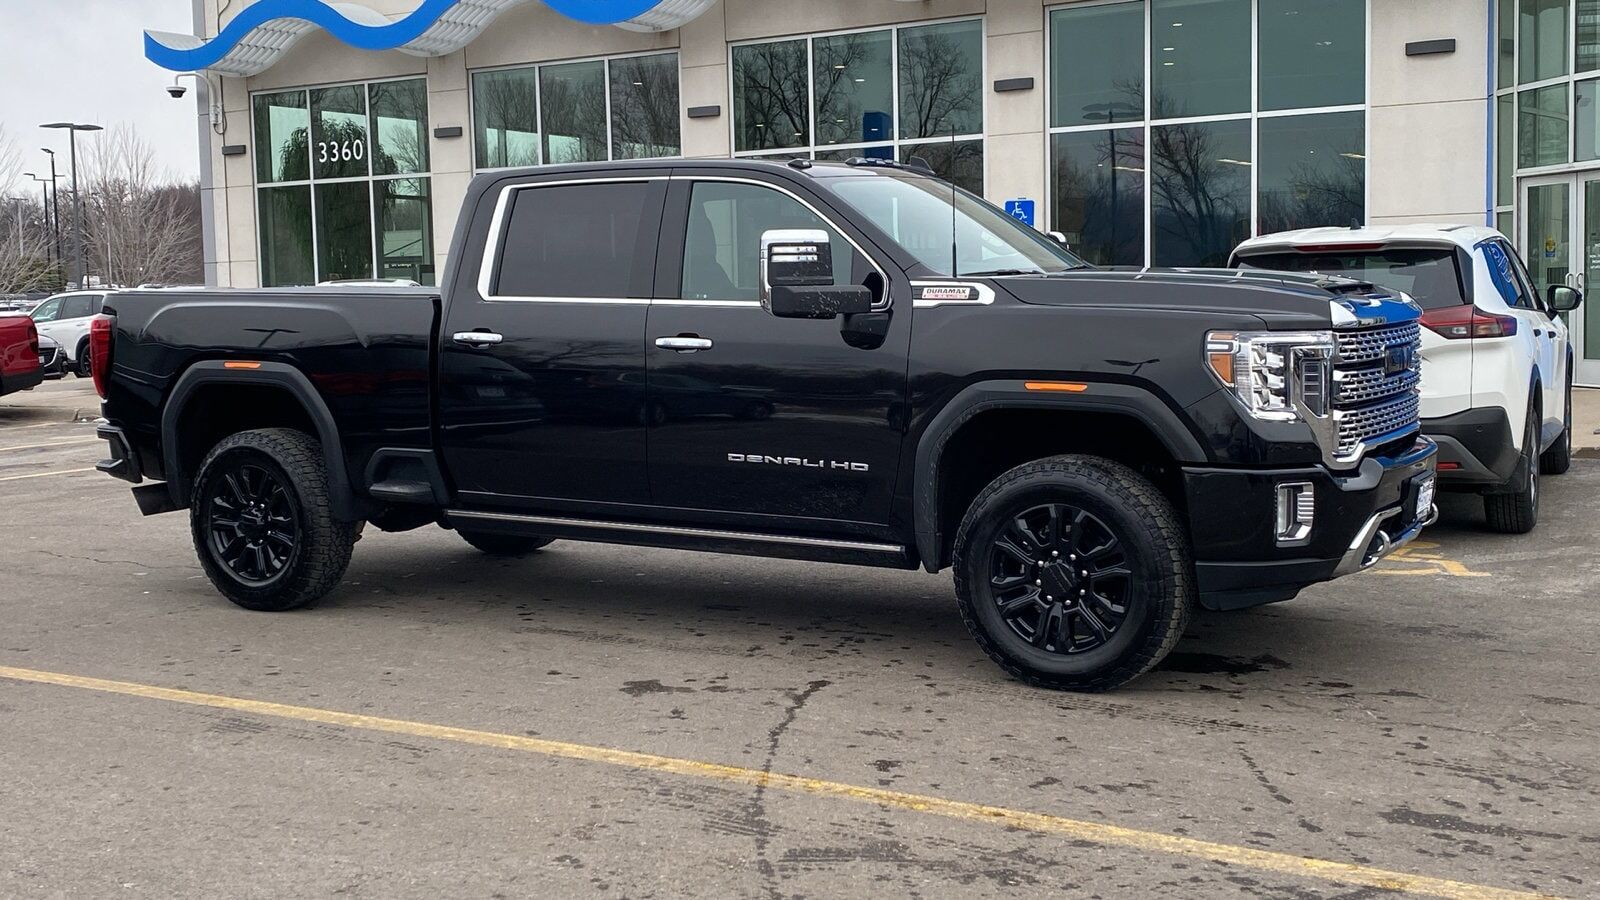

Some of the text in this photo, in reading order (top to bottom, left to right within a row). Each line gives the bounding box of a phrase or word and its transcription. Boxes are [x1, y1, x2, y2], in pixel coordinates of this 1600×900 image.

[318, 139, 363, 163] 3360
[727, 453, 869, 472] DENALI HD
